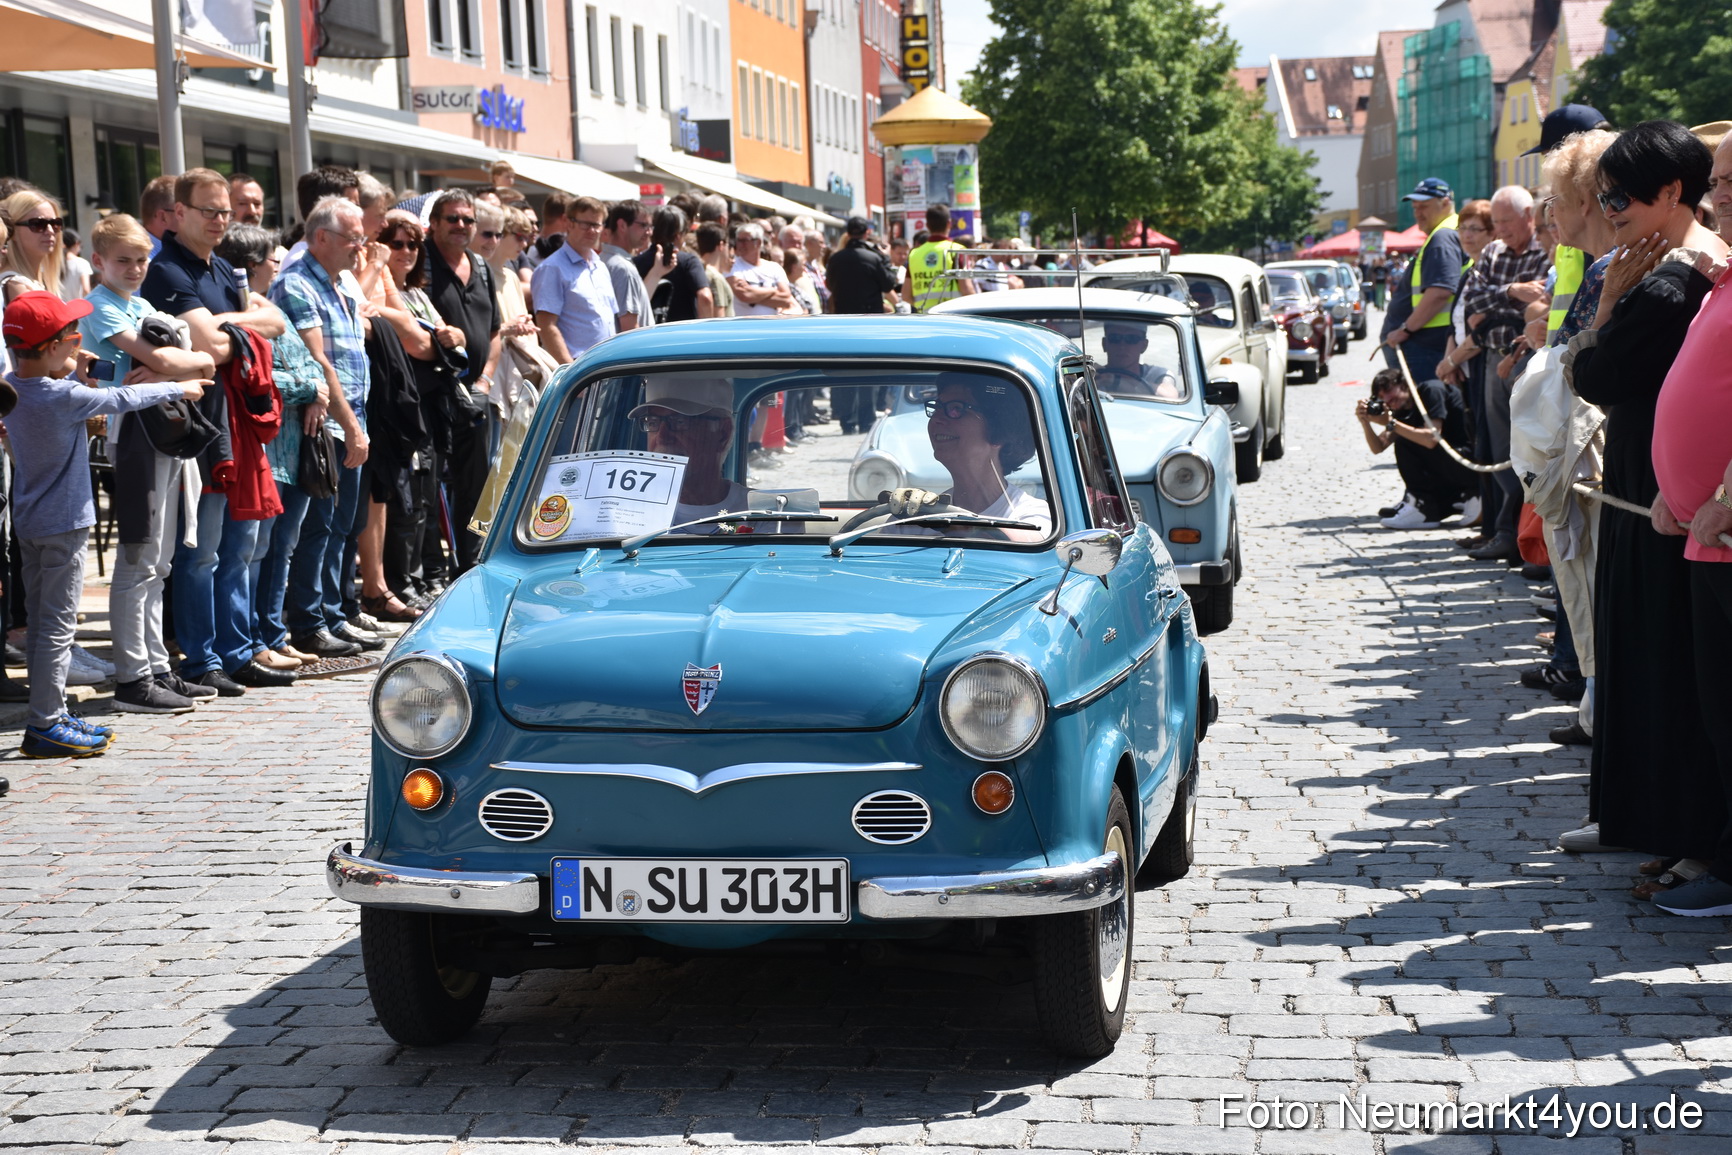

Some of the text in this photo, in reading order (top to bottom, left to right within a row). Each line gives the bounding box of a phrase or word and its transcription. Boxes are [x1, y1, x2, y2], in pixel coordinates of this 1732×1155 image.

[606, 468, 657, 493] 167
[562, 895, 572, 908] D
[583, 866, 613, 913] N
[647, 867, 708, 914] SU
[720, 868, 842, 914] 303H
